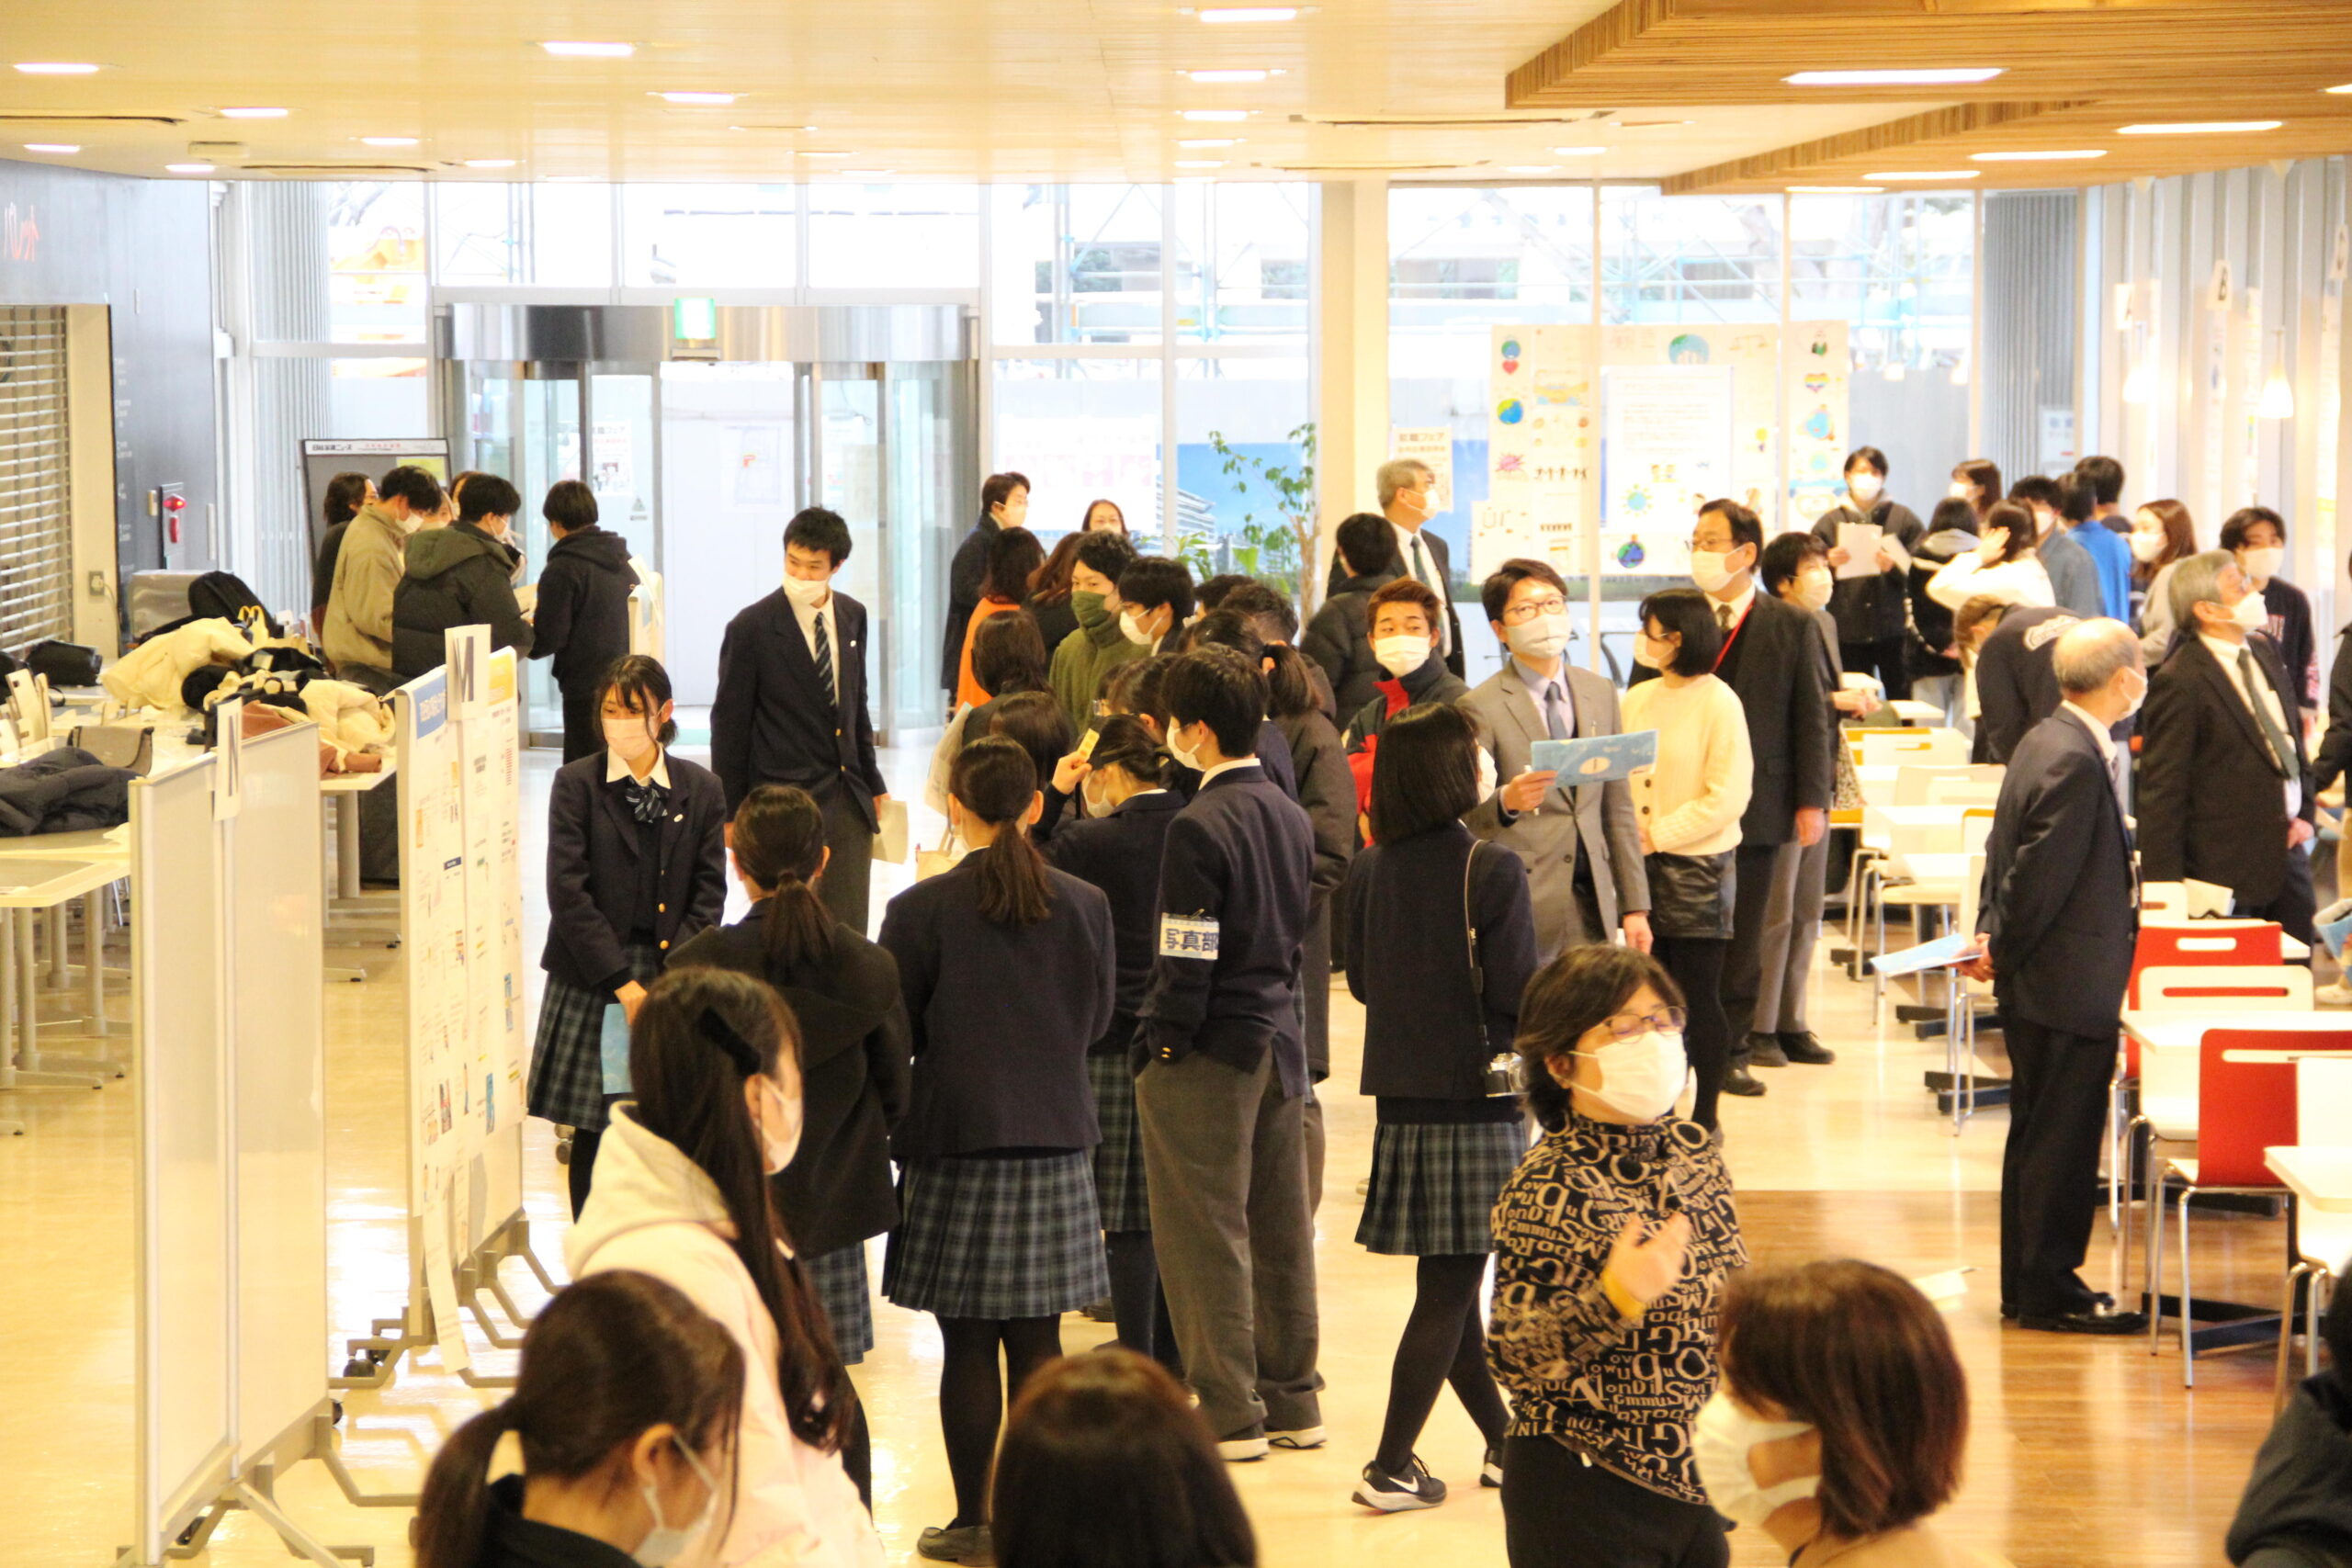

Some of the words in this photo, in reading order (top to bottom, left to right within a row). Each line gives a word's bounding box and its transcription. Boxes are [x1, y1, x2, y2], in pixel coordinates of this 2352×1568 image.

[2217, 266, 2228, 301] B
[1165, 928, 1219, 953] 写真部
